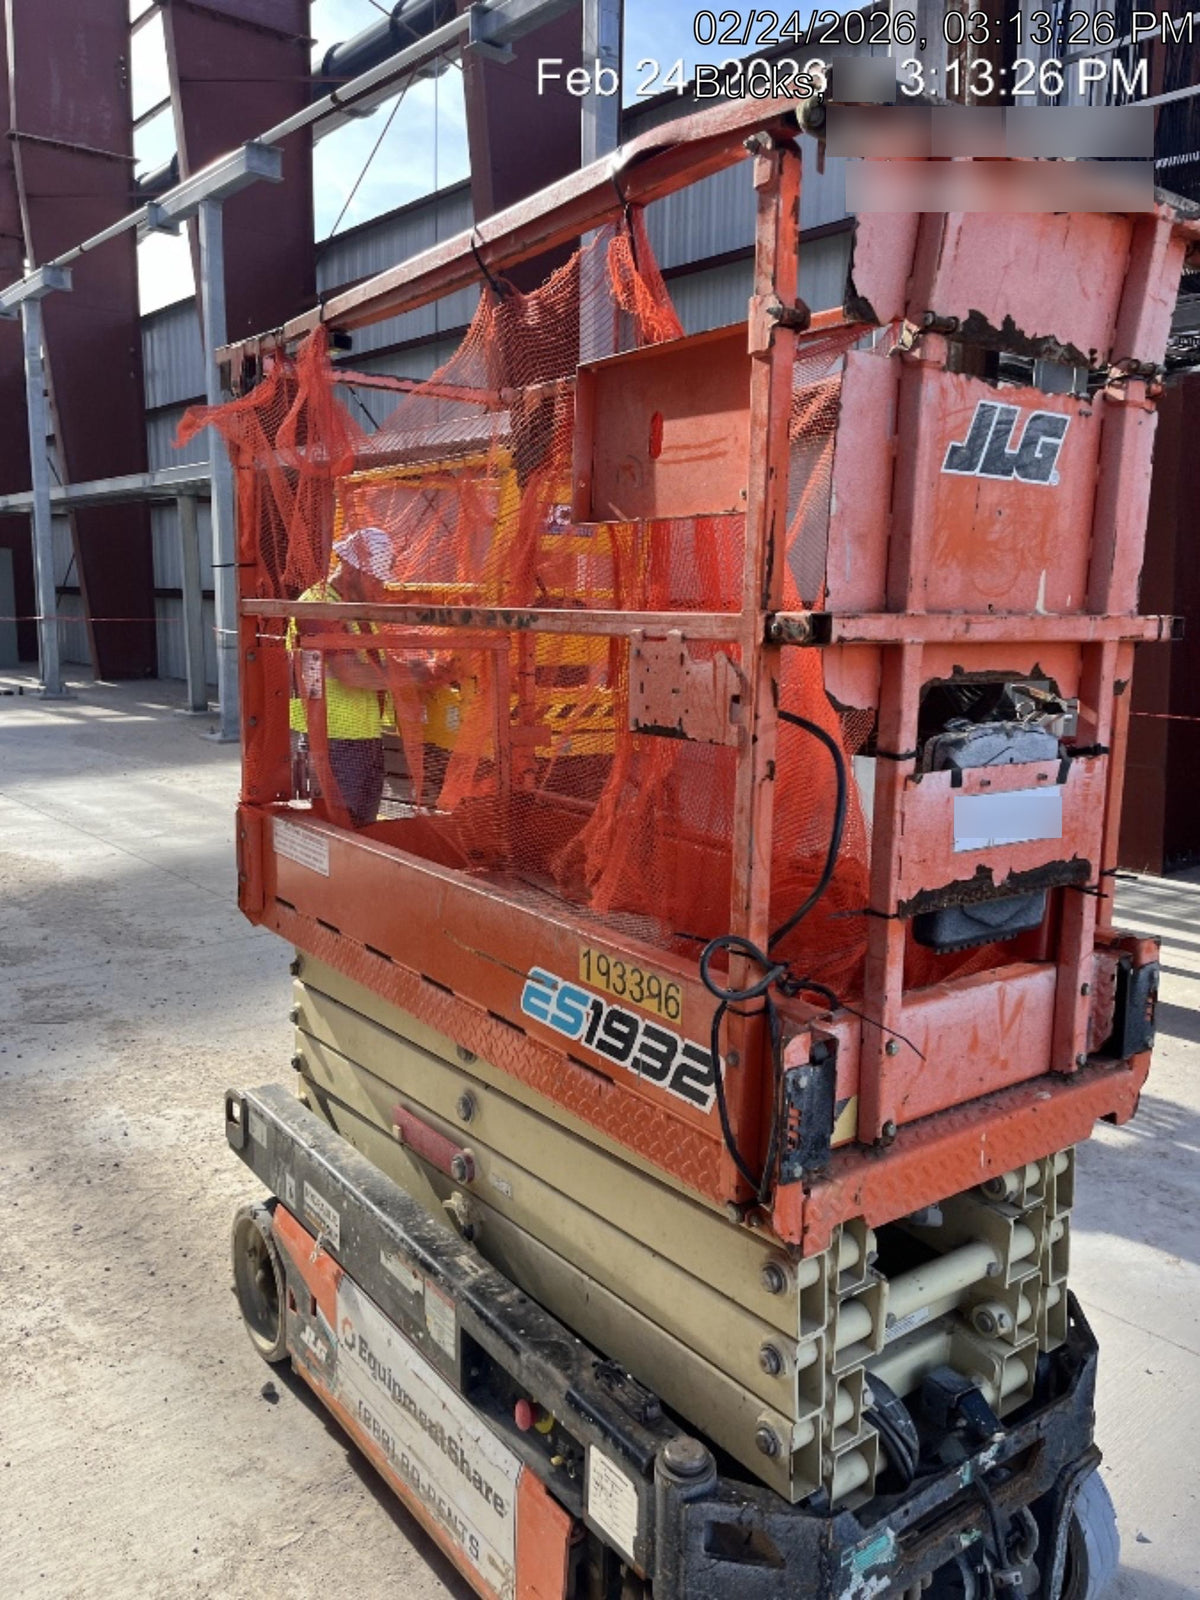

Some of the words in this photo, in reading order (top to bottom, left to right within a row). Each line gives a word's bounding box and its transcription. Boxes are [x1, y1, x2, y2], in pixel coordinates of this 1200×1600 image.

[941, 399, 1071, 485] JLG
[581, 948, 681, 1020] 193396
[521, 966, 725, 1114] ES1932
